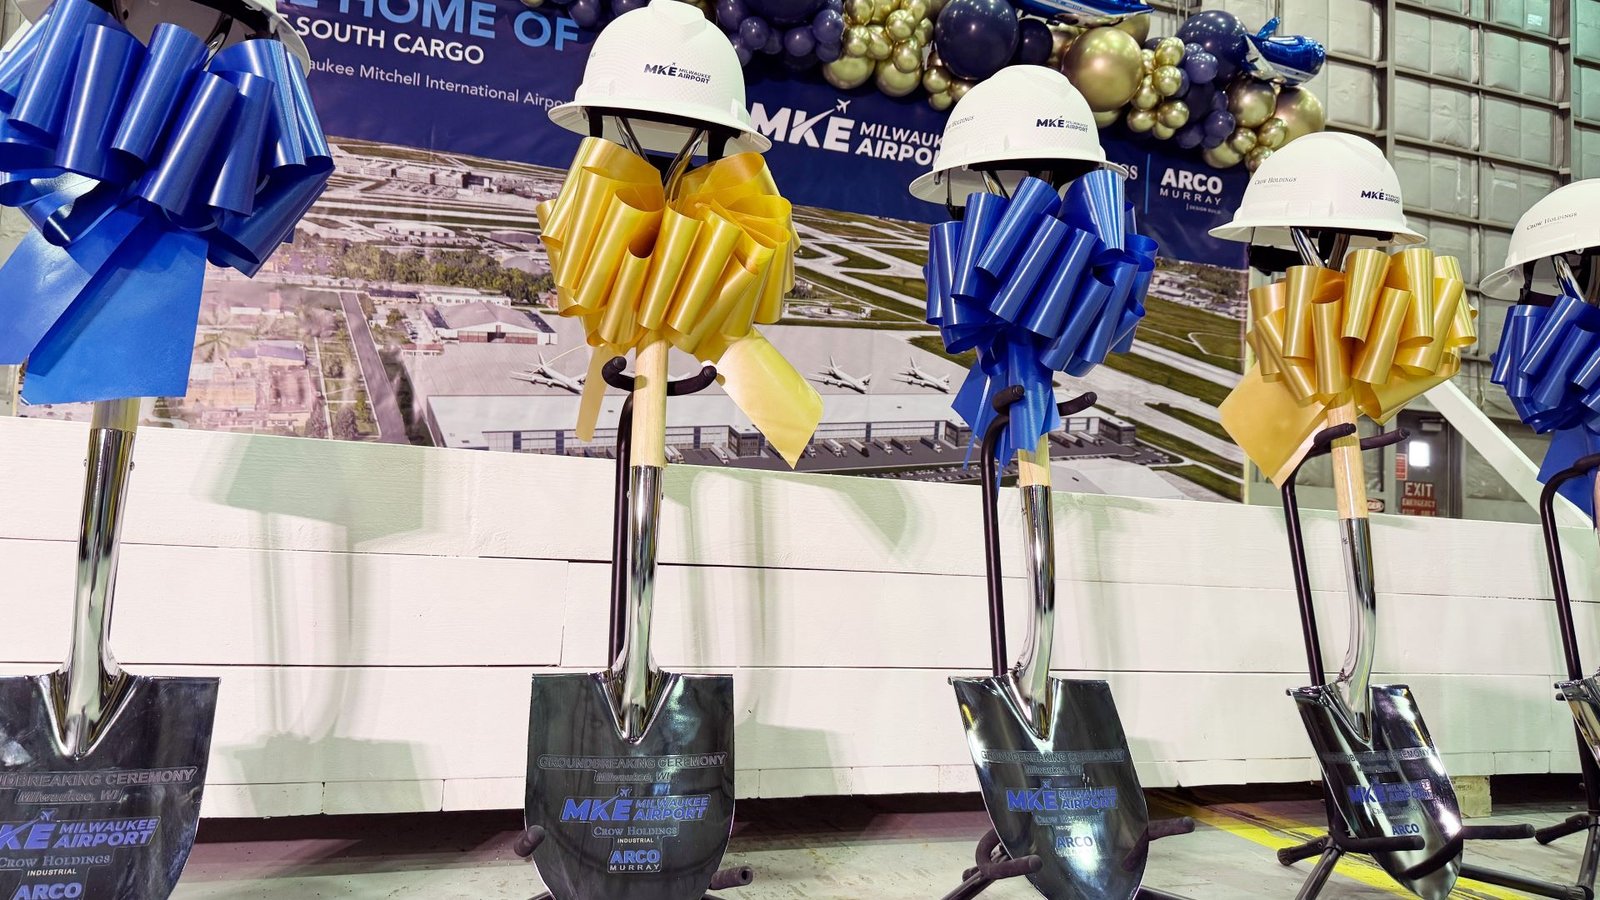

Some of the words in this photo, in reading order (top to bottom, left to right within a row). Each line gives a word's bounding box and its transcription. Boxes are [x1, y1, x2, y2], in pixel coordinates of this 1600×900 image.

[513, 10, 580, 51] OF
[295, 16, 385, 49] SOUTH
[393, 33, 485, 65] CARGO
[643, 63, 678, 77] MKE
[678, 68, 711, 79] MILWAUKEE
[677, 72, 711, 84] AIRPORT
[309, 58, 355, 77] aukee
[360, 64, 420, 87] Mitchell
[425, 74, 519, 103] International
[523, 91, 567, 112] Airpo
[750, 101, 855, 153] MKE
[859, 121, 943, 148] MILWAUK
[1036, 118, 1065, 128] MKE
[1065, 123, 1088, 132] AIRPORT
[854, 137, 940, 168] AIRPO
[1160, 167, 1223, 195] ARCO
[1159, 187, 1222, 206] MURRAY
[1360, 190, 1385, 201] MKE
[1544, 212, 1578, 224] HOLDINGS
[1405, 482, 1433, 497] EXIT
[539, 756, 656, 769] GROUNDBREAKING
[658, 753, 727, 768] CEREMONY
[105, 769, 196, 786] CEREMONY
[100, 788, 120, 801] WI
[1006, 789, 1058, 810] MKE
[562, 799, 633, 821] MKE
[635, 797, 709, 808] MILWAUKEE
[1061, 797, 1116, 809] AIRPORT
[633, 806, 707, 821] AIRPORT
[0, 823, 57, 850] KE
[59, 818, 158, 835] MILWAUKEE
[593, 826, 623, 836] CROW
[627, 826, 678, 836] HOLDINGS
[1392, 823, 1420, 835] ARCO
[52, 830, 153, 849] AIRPORT
[1056, 836, 1093, 849] ARCO
[0, 856, 38, 868] CROW
[42, 854, 111, 867] HOLDINGS
[610, 850, 661, 864] ARCO
[27, 868, 77, 877] INDUSTRIAL
[609, 864, 661, 872] MURRAY
[11, 882, 83, 900] ARCO
